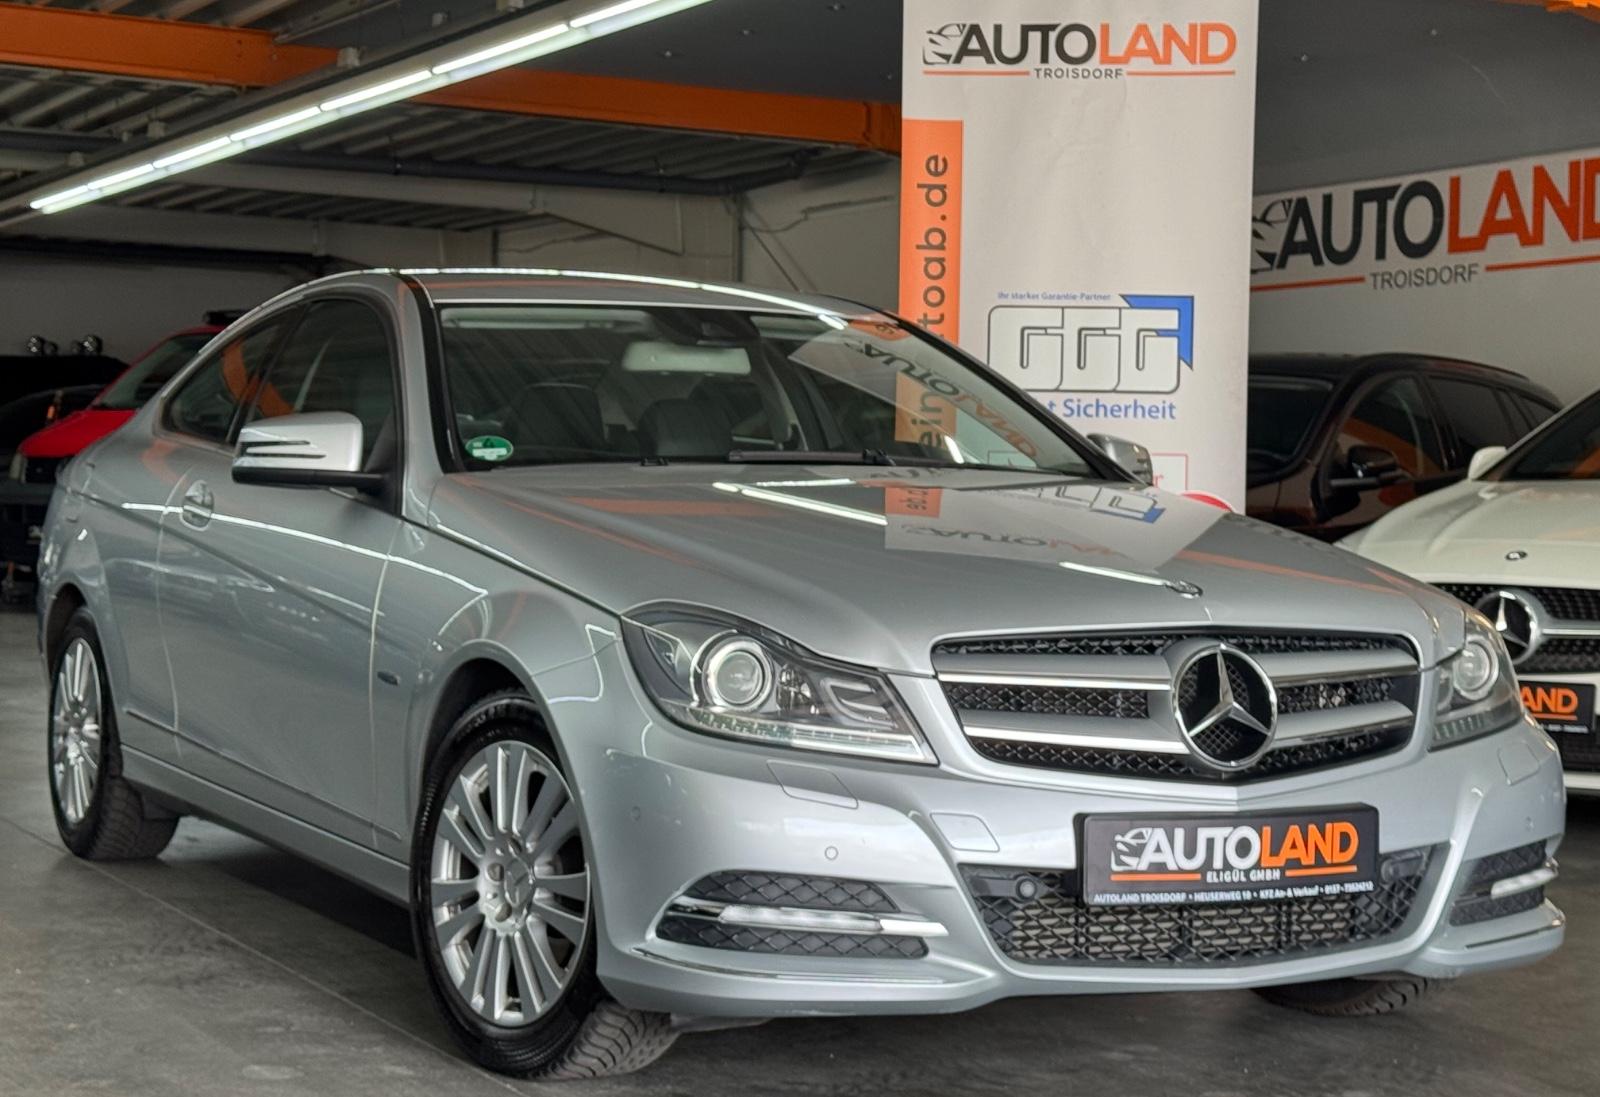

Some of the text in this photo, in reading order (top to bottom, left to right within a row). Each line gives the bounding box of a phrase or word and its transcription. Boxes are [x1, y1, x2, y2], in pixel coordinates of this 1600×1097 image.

[951, 22, 1237, 65] AUTOLAND
[1034, 67, 1123, 80] TROISDORF
[1370, 263, 1480, 290] TROISDORF
[1062, 398, 1177, 419] Sicherheit
[1136, 821, 1359, 872] AUTOLAND
[1093, 892, 1140, 903] AUTOLAND
[1141, 891, 1187, 903] TROISDORF
